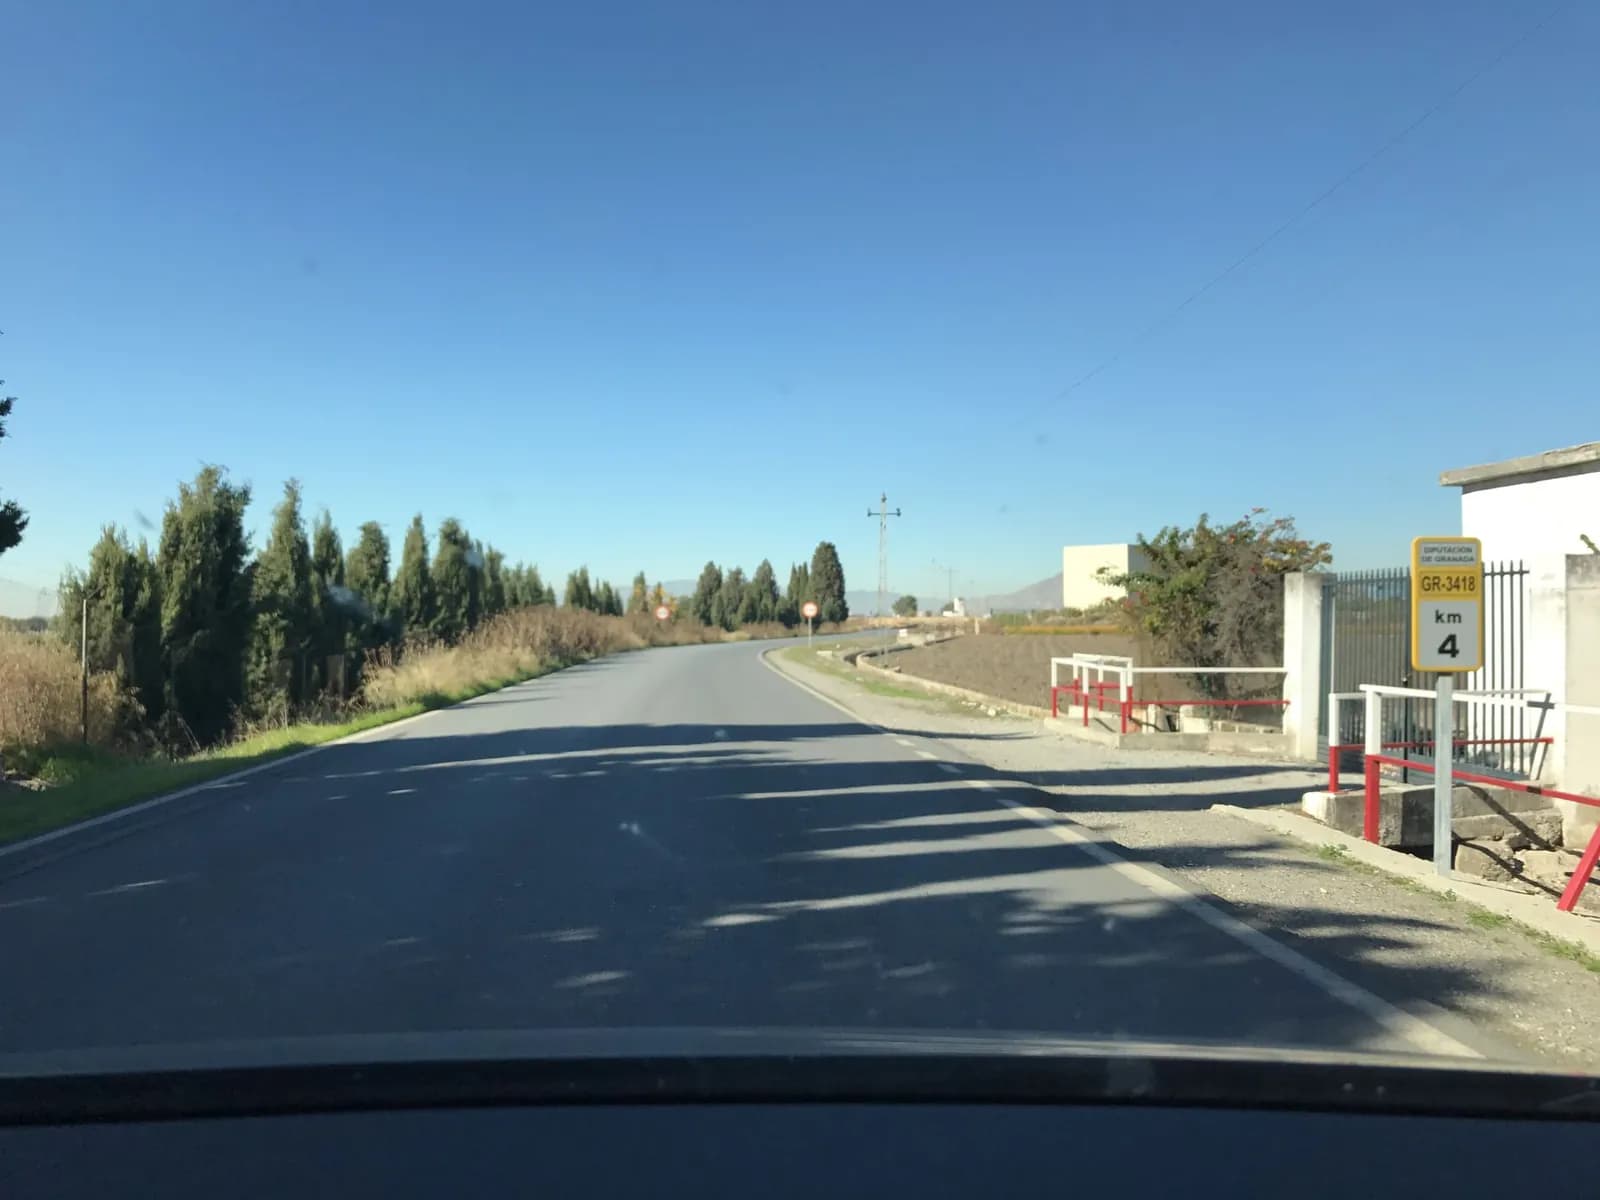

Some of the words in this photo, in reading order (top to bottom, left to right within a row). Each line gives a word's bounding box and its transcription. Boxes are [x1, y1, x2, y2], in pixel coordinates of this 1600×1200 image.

[1421, 575, 1476, 592] GR-3418
[1434, 609, 1462, 624] km
[1437, 633, 1460, 658] 4
